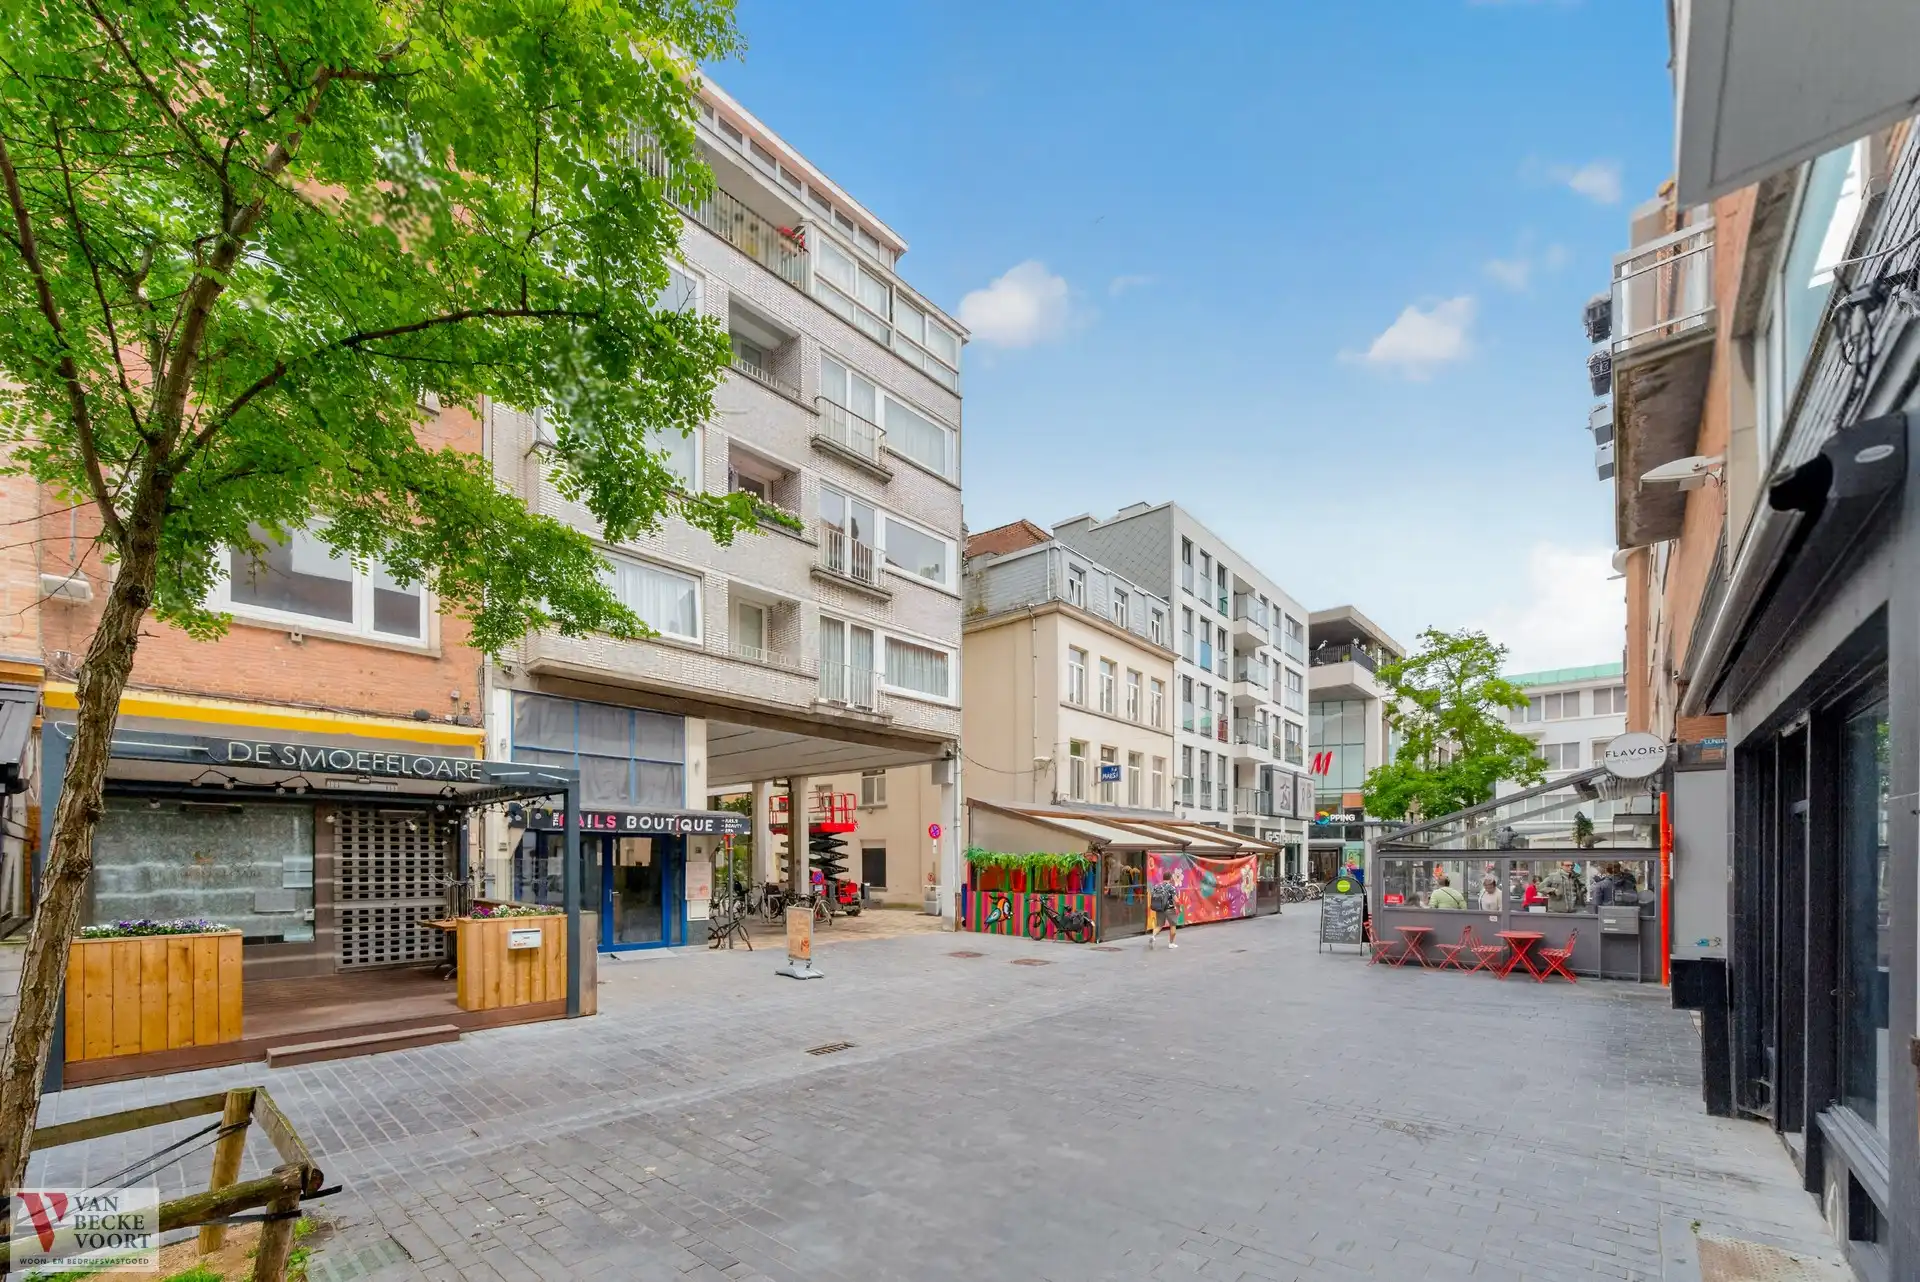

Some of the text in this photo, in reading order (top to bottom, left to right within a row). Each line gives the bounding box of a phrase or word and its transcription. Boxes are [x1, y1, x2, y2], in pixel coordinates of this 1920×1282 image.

[227, 741, 482, 780] DE SMOEFELOARE
[1605, 746, 1665, 758] FLAVORS
[552, 812, 560, 827] THE
[626, 815, 714, 833] BOUTIQUE
